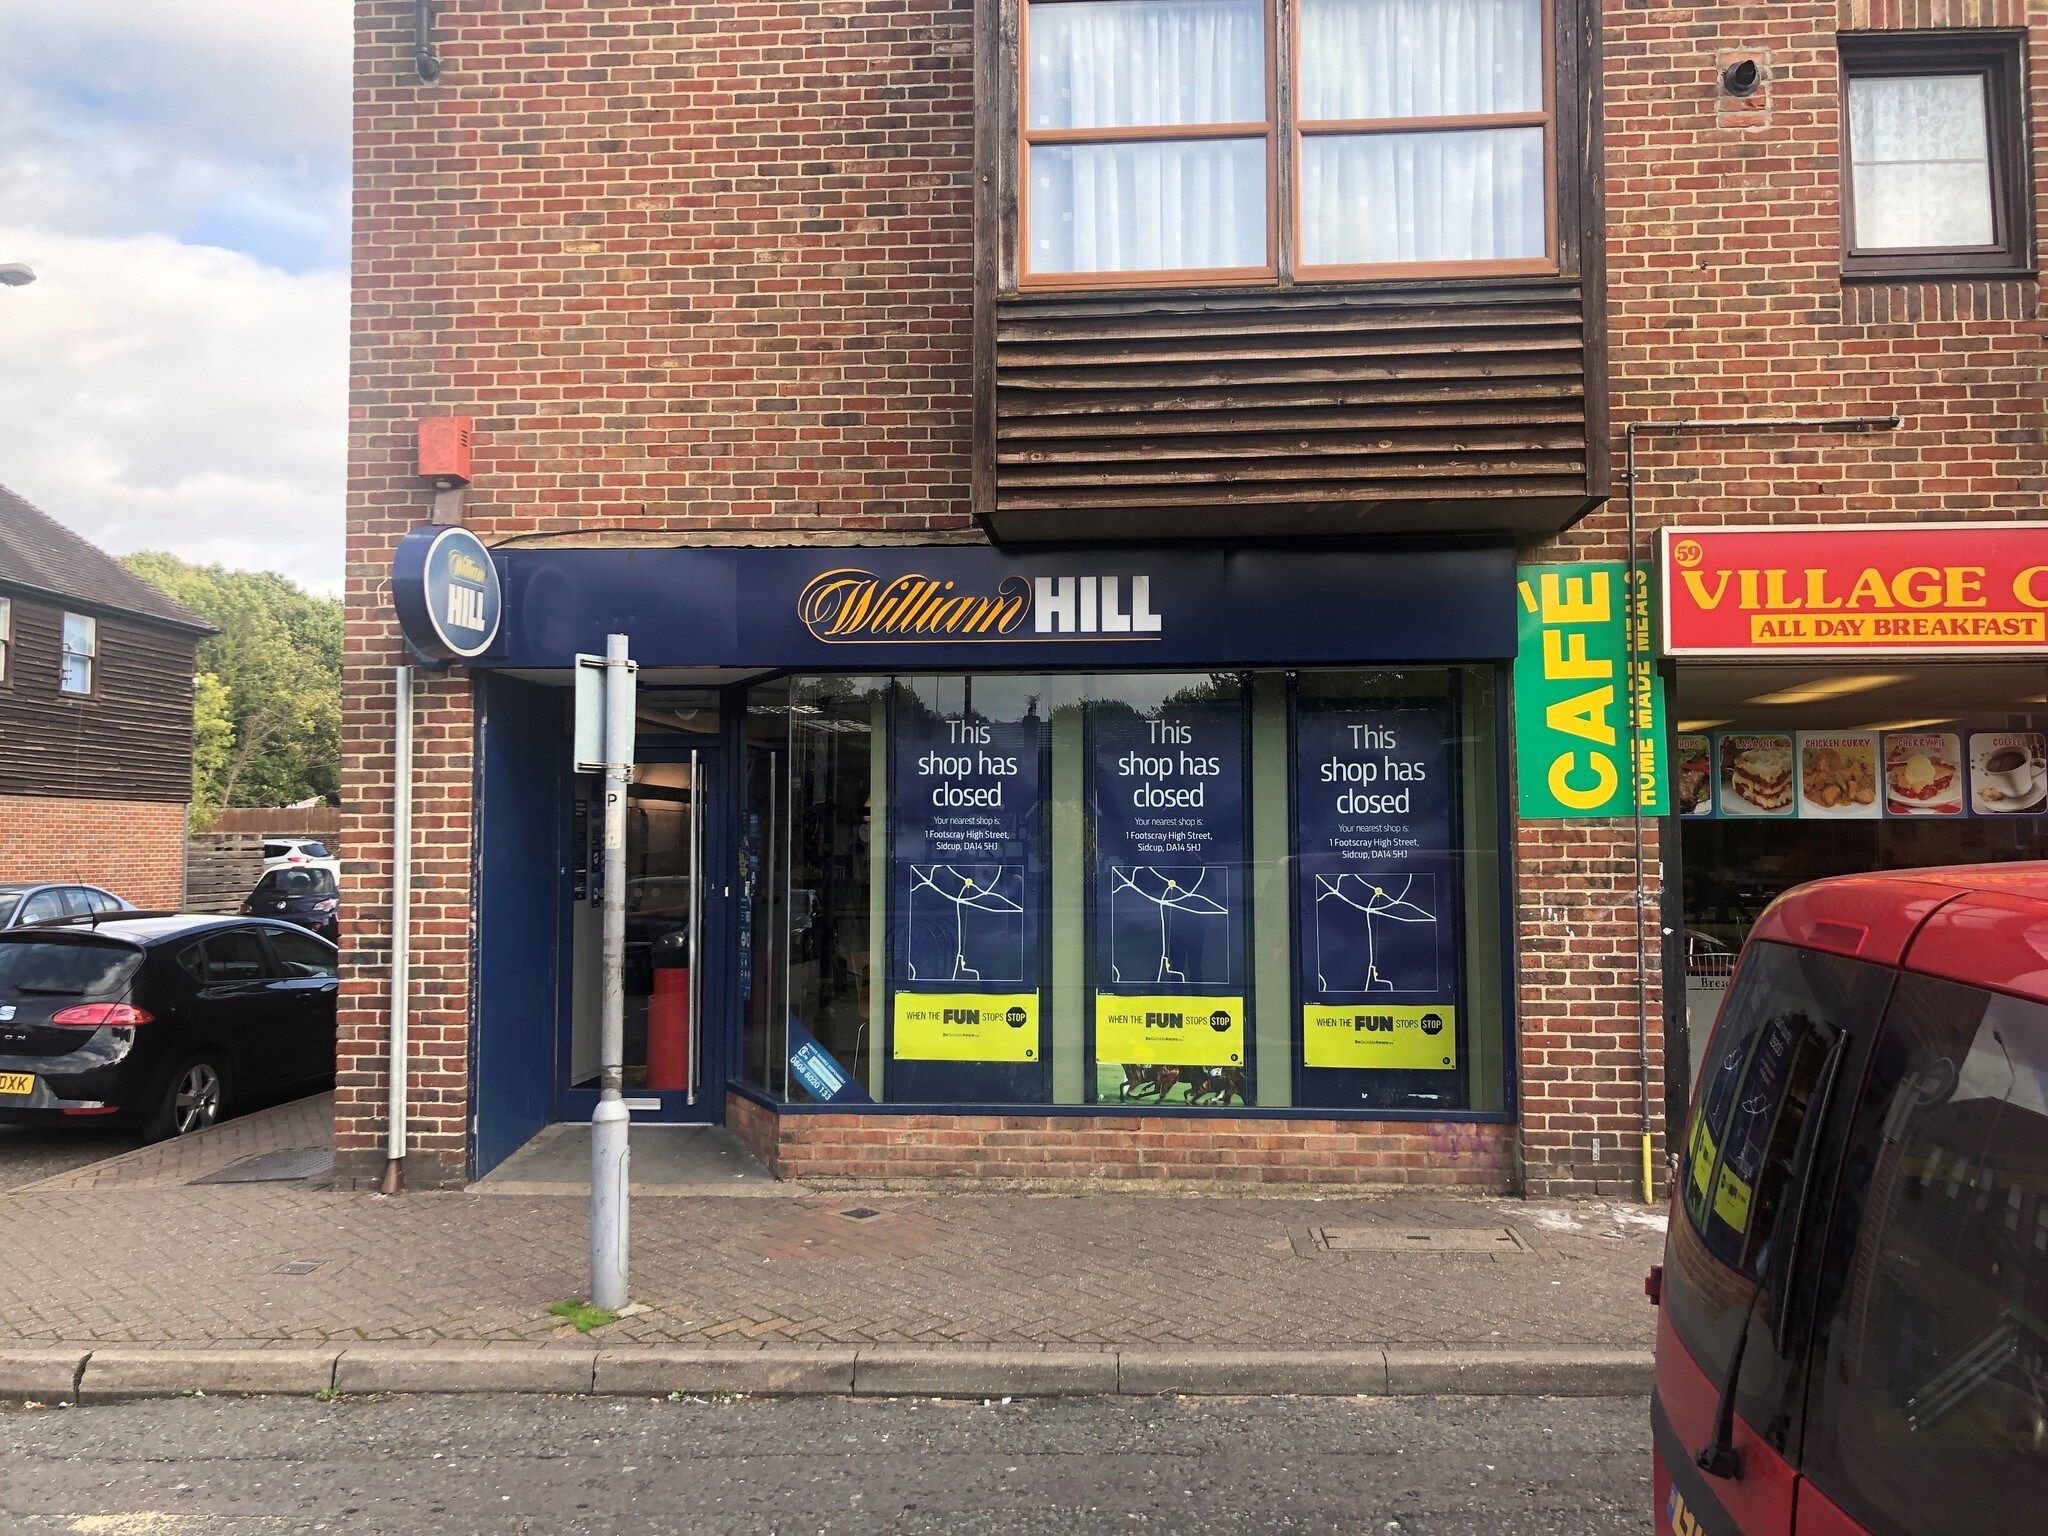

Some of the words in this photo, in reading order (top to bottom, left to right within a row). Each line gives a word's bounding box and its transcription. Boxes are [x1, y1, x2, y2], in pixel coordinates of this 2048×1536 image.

[1676, 545, 1700, 562] 59
[1680, 566, 1987, 610] VILLAGE
[447, 583, 486, 632] HILL
[797, 568, 1032, 635] William
[1034, 575, 1162, 633] HILL
[1624, 569, 1650, 651] MEALS
[1758, 619, 1807, 638] ALL
[1814, 618, 1866, 637] DAY
[1873, 617, 2038, 637] BREAKFAST
[1517, 571, 1618, 810] CAFÉ
[1627, 660, 1653, 729] MADE
[946, 719, 991, 744] This
[1145, 719, 1192, 744] This
[1347, 723, 1396, 749] This
[1677, 739, 1699, 749] HOPS
[1805, 739, 1840, 748] CHICKEN
[1841, 739, 1870, 748] CURRY
[1898, 738, 1930, 747] CHERRY
[1933, 738, 1946, 747] PIE
[1993, 738, 2021, 746] COFFEE
[918, 750, 972, 781] shop
[978, 750, 1018, 775] has
[1118, 750, 1173, 781] shop
[1180, 750, 1220, 776] has
[1320, 756, 1377, 787] shop
[1384, 755, 1426, 781] has
[1630, 738, 1656, 806] HOME
[607, 793, 618, 807] P
[932, 781, 1002, 807] closed
[1133, 782, 1204, 808] closed
[1336, 787, 1410, 814] closed
[933, 816, 949, 825] Your
[950, 817, 975, 825] nearest
[976, 816, 992, 826] shop
[992, 816, 1000, 825] is:
[1134, 817, 1150, 826] Your
[1151, 817, 1177, 826] nearest
[1178, 817, 1195, 827] shop
[1338, 824, 1354, 832] Your
[1355, 824, 1382, 832] nearest
[1383, 824, 1401, 833] shop
[930, 830, 965, 840] Footscray
[966, 830, 984, 840] High
[985, 830, 1010, 840] Street,
[1130, 831, 1167, 841] Footscray
[1168, 831, 1186, 841] High
[1187, 831, 1213, 841] Street,
[1334, 838, 1372, 848] Footscray
[1374, 838, 1392, 848] High
[1393, 838, 1419, 848] Street,
[936, 842, 962, 851] Sidcup,
[964, 842, 982, 850] DA14
[984, 842, 998, 850] 5HJ
[1137, 843, 1164, 852] Sidcup,
[1166, 843, 1185, 851] DA14
[1186, 843, 1201, 851] 5HJ
[1342, 850, 1370, 859] Sidcup,
[1371, 850, 1391, 858] DA14
[1393, 850, 1408, 858] 5HJ
[1701, 977, 1731, 988] Brea
[906, 1011, 926, 1020] WHEN
[928, 1012, 941, 1020] THE
[943, 1009, 980, 1025] FUN
[982, 1012, 1004, 1021] STOPS
[1007, 1013, 1025, 1022] STOP
[1108, 1015, 1128, 1023] WHEN
[1130, 1015, 1143, 1024] THE
[1145, 1013, 1183, 1028] FUN
[1185, 1016, 1208, 1025] STOPS
[1211, 1017, 1230, 1026] STOP
[1316, 1018, 1337, 1027] WHEN
[1339, 1018, 1352, 1027] THE
[1354, 1015, 1394, 1032] FUN
[1396, 1018, 1419, 1029] STOPS
[1422, 1019, 1442, 1029] STOP
[790, 1056, 806, 1074] 0808
[804, 1071, 820, 1089] 8020
[818, 1087, 832, 1101] 133
